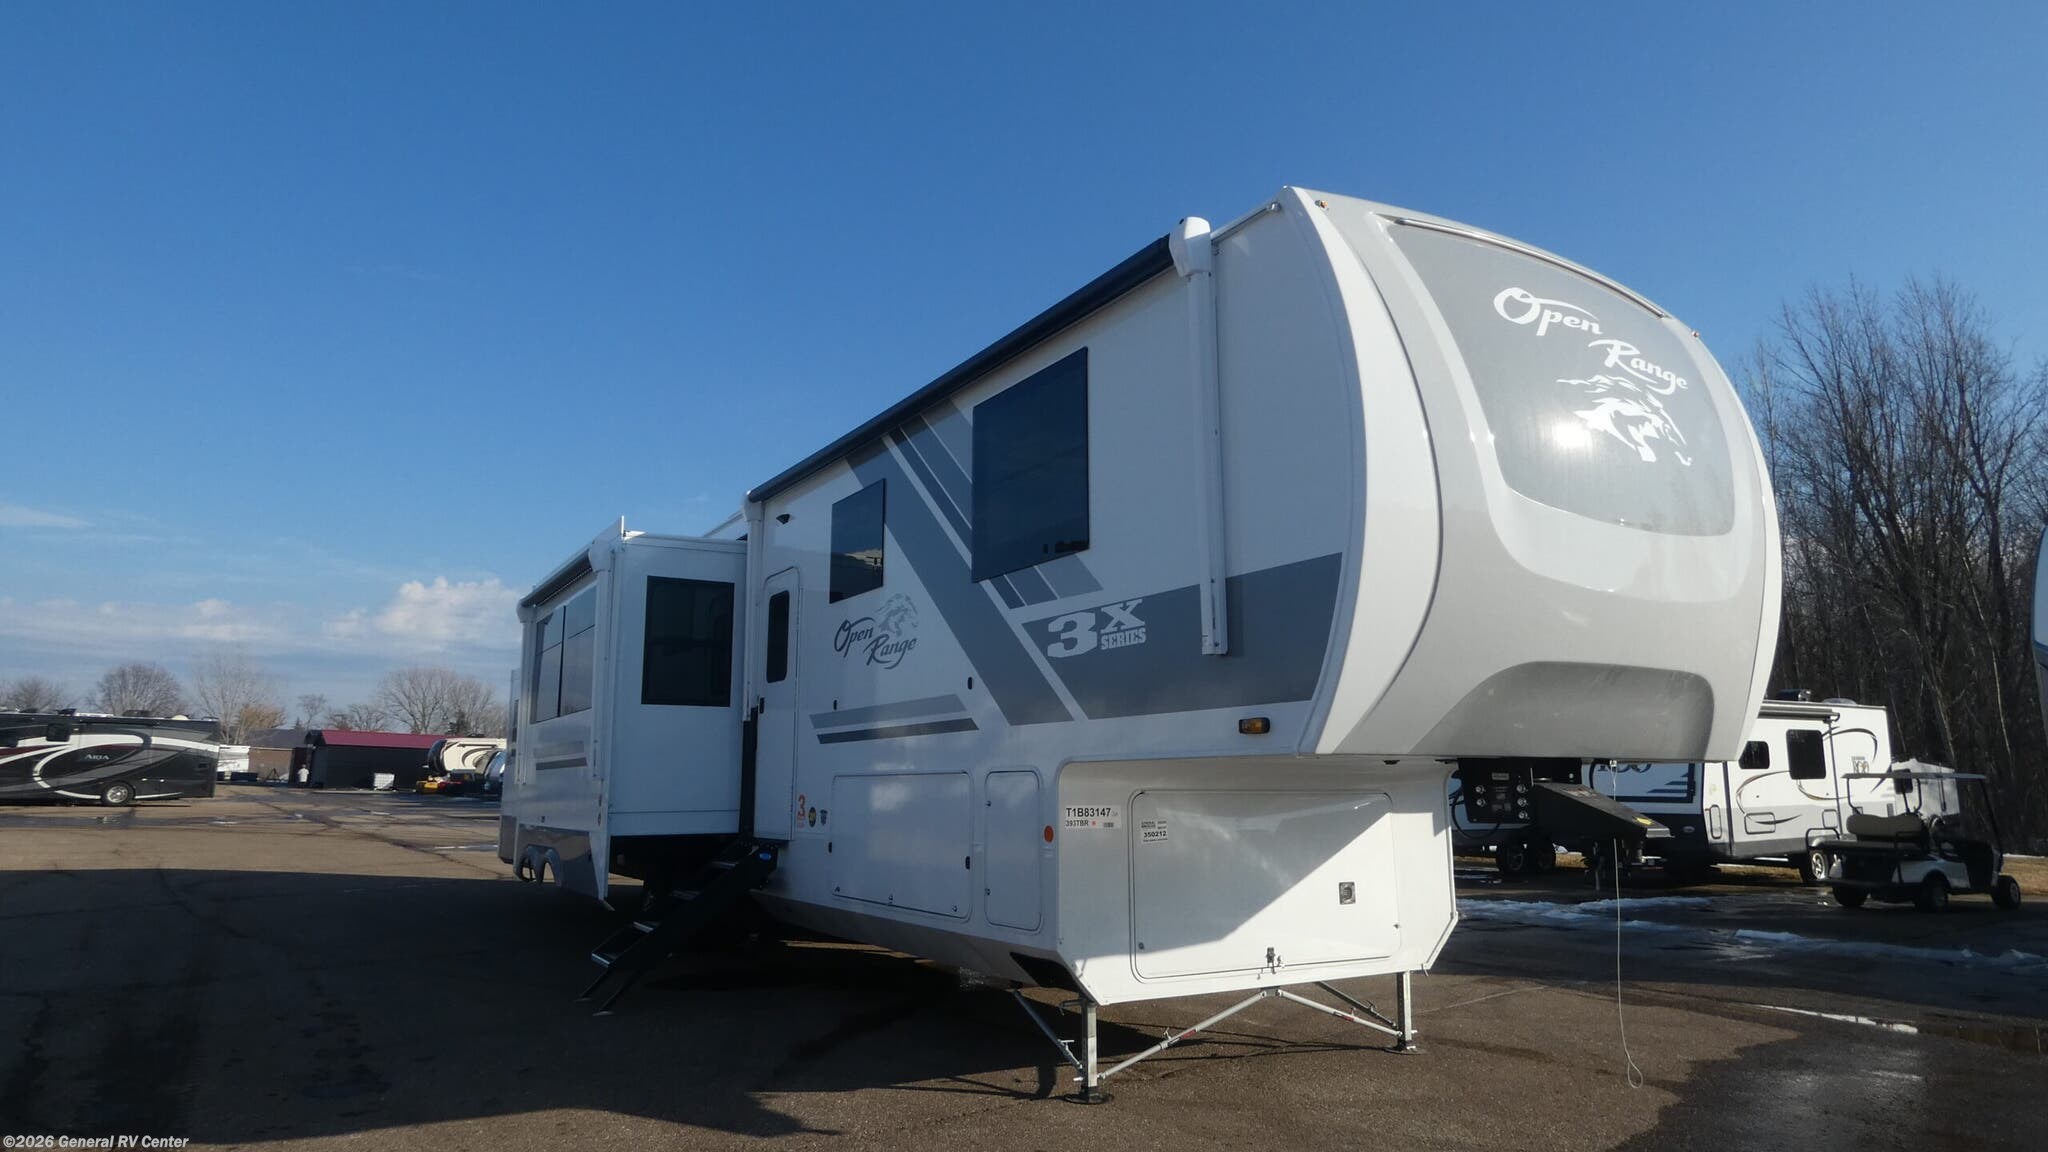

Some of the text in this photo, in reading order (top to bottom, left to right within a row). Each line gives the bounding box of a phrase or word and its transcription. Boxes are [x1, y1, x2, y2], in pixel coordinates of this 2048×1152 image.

[1493, 287, 1603, 336] Open
[1588, 339, 1688, 395] Range
[834, 616, 874, 657] Open
[863, 636, 917, 669] Range
[1100, 627, 1147, 650] SERIES
[1066, 807, 1111, 817] T1B83147
